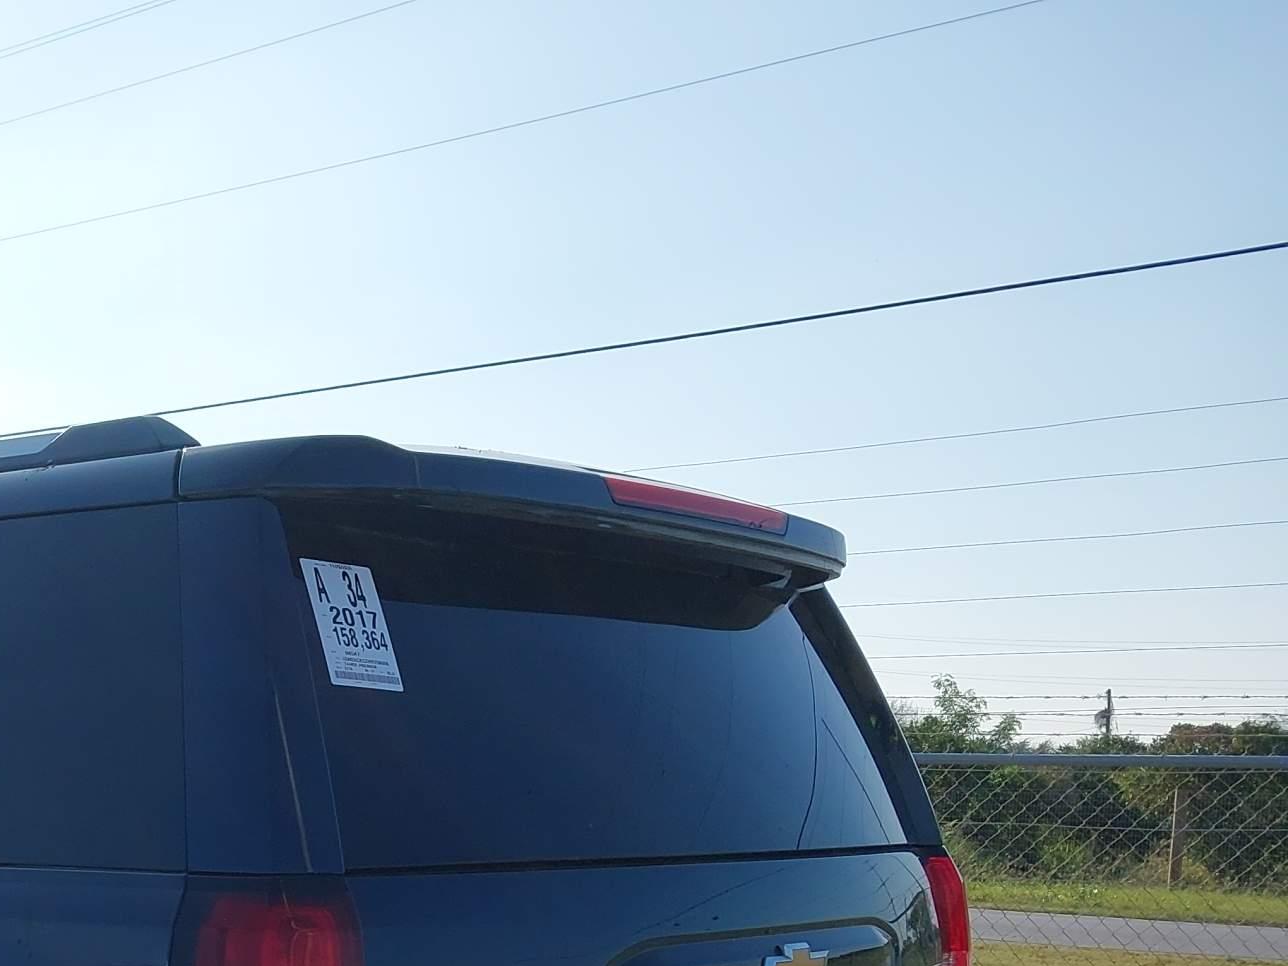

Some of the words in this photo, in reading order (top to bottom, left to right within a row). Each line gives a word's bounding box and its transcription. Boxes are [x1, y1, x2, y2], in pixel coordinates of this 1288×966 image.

[313, 567, 331, 604] A
[342, 571, 368, 608] 34
[329, 605, 377, 629] 2017
[332, 626, 389, 652] 158,364
